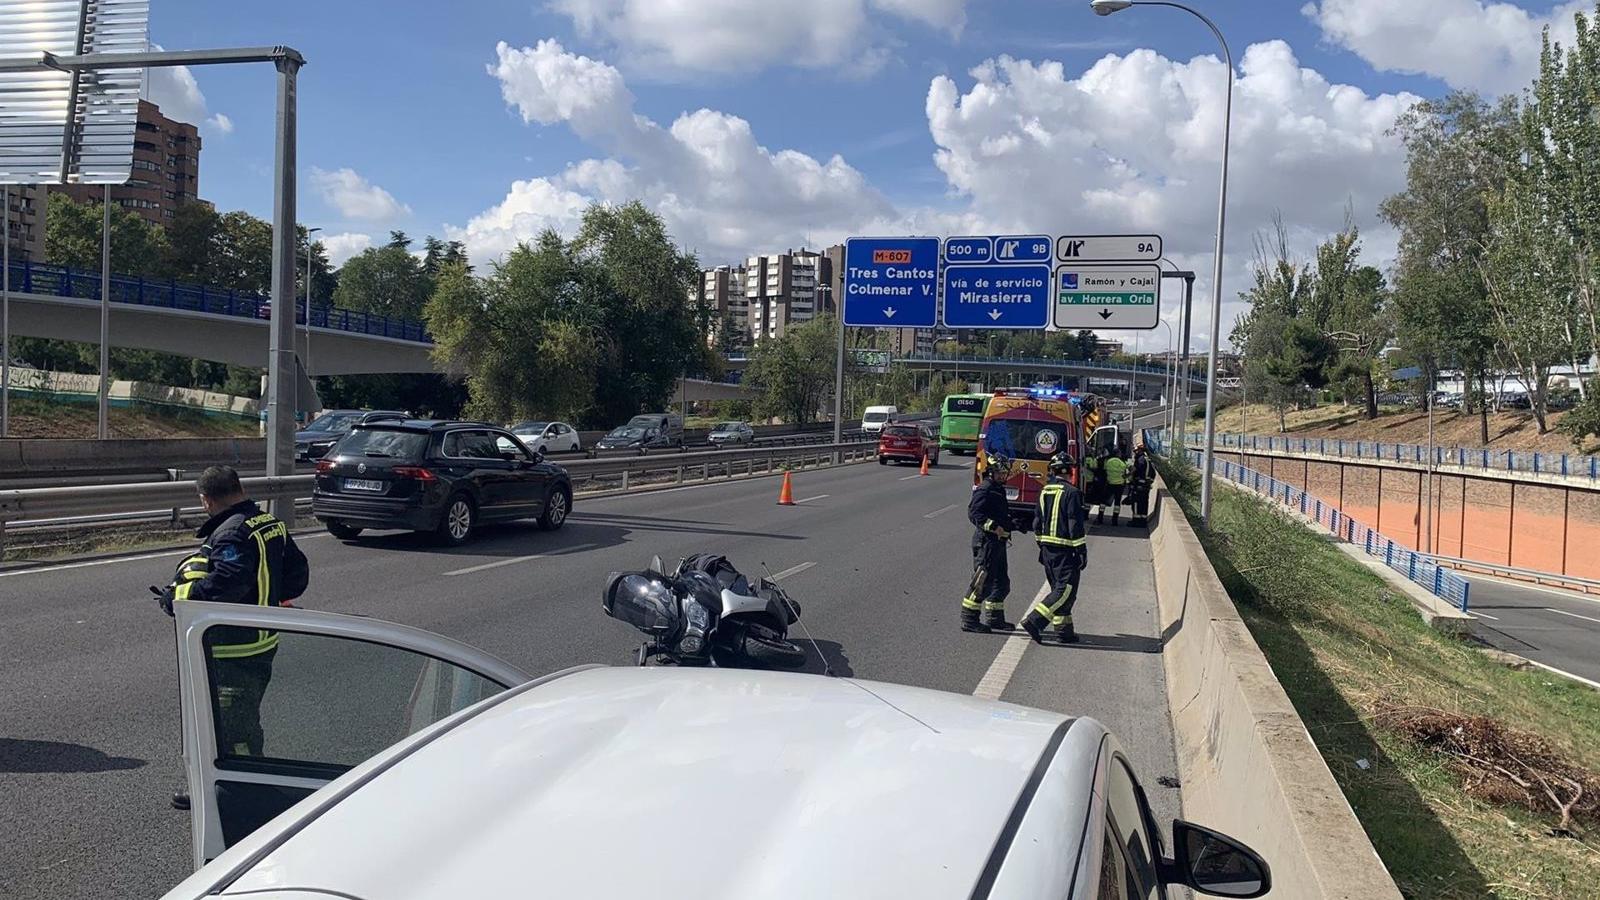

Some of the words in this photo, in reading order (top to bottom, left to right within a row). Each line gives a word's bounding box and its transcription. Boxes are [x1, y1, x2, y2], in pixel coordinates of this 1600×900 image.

[949, 245, 972, 255] 500
[977, 247, 987, 255] m
[1032, 244, 1047, 254] 9B
[1137, 243, 1154, 253] 9A
[875, 252, 909, 261] M-607
[849, 267, 878, 278] Tres
[885, 267, 934, 279] Cantos
[951, 278, 967, 288] vía
[975, 278, 989, 288] de
[995, 278, 1042, 288] servicio
[1084, 277, 1115, 285] Ramón
[1120, 279, 1126, 287] y
[1130, 277, 1154, 287] Cajal
[848, 283, 913, 295] Colmenar
[922, 284, 933, 295] V.
[960, 291, 1031, 303] Mirasierra
[1082, 294, 1122, 303] Herrera
[1129, 294, 1152, 303] Oria
